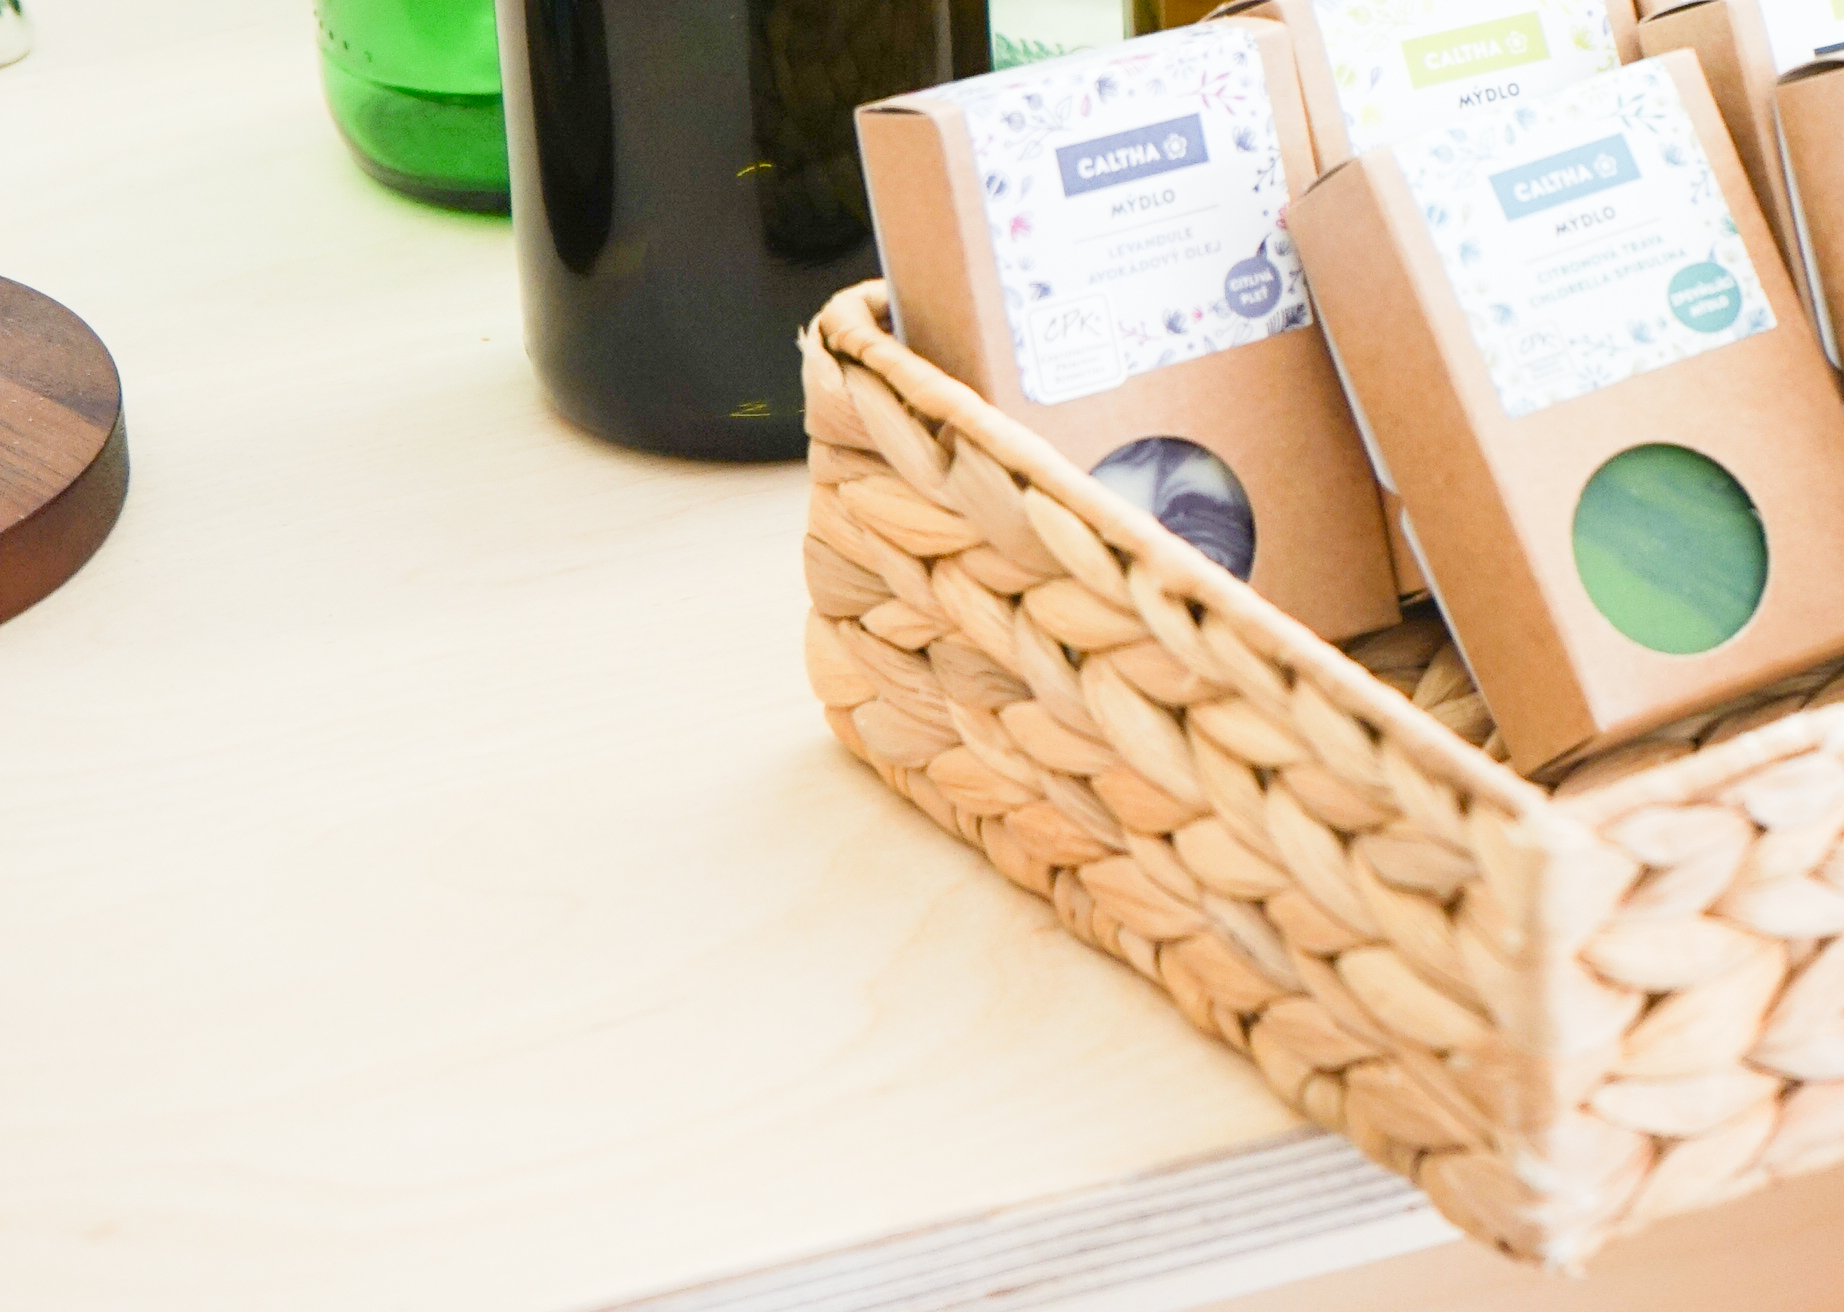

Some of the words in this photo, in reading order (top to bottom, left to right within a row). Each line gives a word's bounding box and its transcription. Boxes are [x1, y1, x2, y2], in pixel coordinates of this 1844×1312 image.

[1423, 42, 1504, 70] CALTHA
[1459, 81, 1521, 110] MÝDLO
[1077, 142, 1162, 179] CALTHA
[1513, 167, 1594, 203] CALTHA
[1111, 188, 1176, 217] MÝDLO
[1555, 204, 1617, 237] MÝDLO
[1108, 226, 1194, 259] LEVANDULE
[1184, 240, 1222, 259] OLEJ
